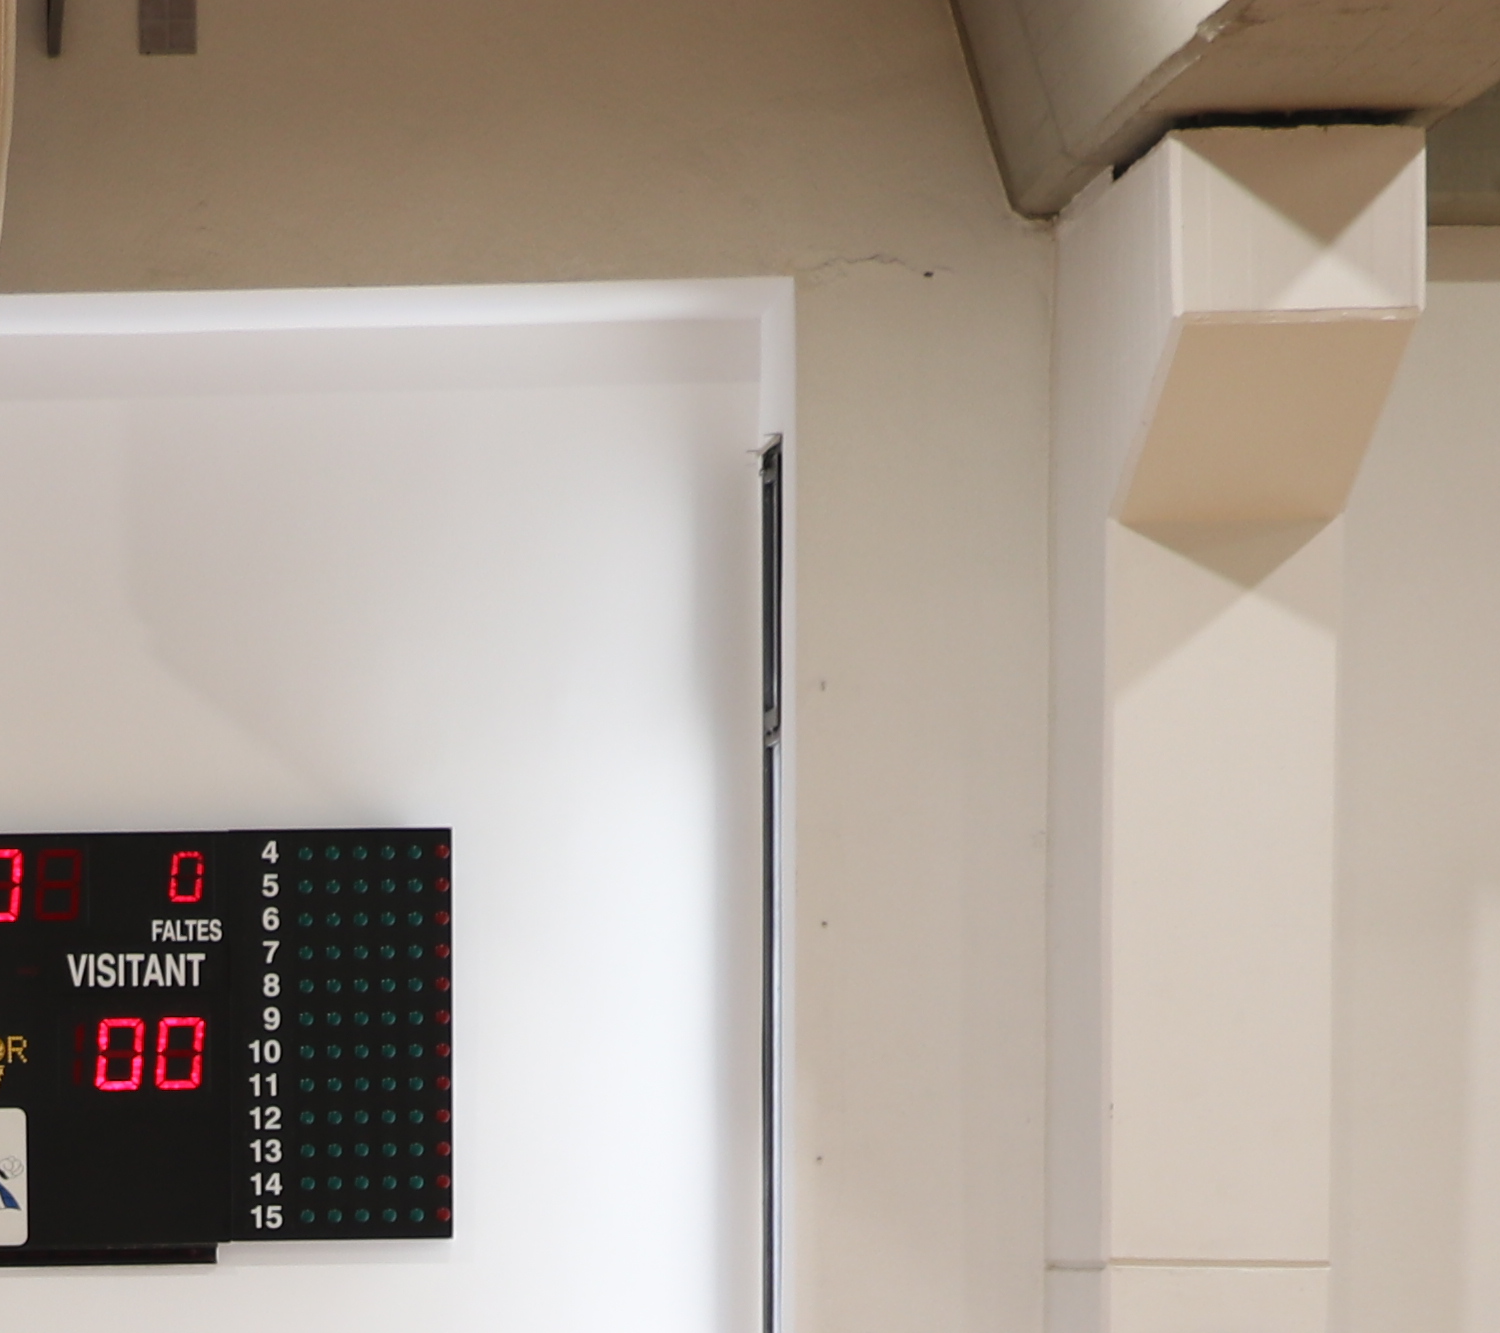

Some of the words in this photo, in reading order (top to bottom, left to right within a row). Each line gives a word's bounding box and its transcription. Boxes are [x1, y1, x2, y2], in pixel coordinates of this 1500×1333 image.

[261, 840, 279, 864] 4
[168, 851, 204, 903] 0
[262, 873, 279, 898] 5
[151, 919, 222, 942] FALTES
[262, 906, 280, 931] 6
[262, 940, 280, 964] 7
[67, 953, 206, 988] VISITANT
[263, 973, 280, 997] 8
[263, 1006, 281, 1031] 9
[94, 1016, 206, 1092] 00
[248, 1039, 281, 1064] 10
[249, 1072, 278, 1097] 11
[249, 1106, 282, 1130] 12
[249, 1139, 282, 1163] 13
[250, 1172, 283, 1196] 14
[250, 1205, 283, 1229] 15
